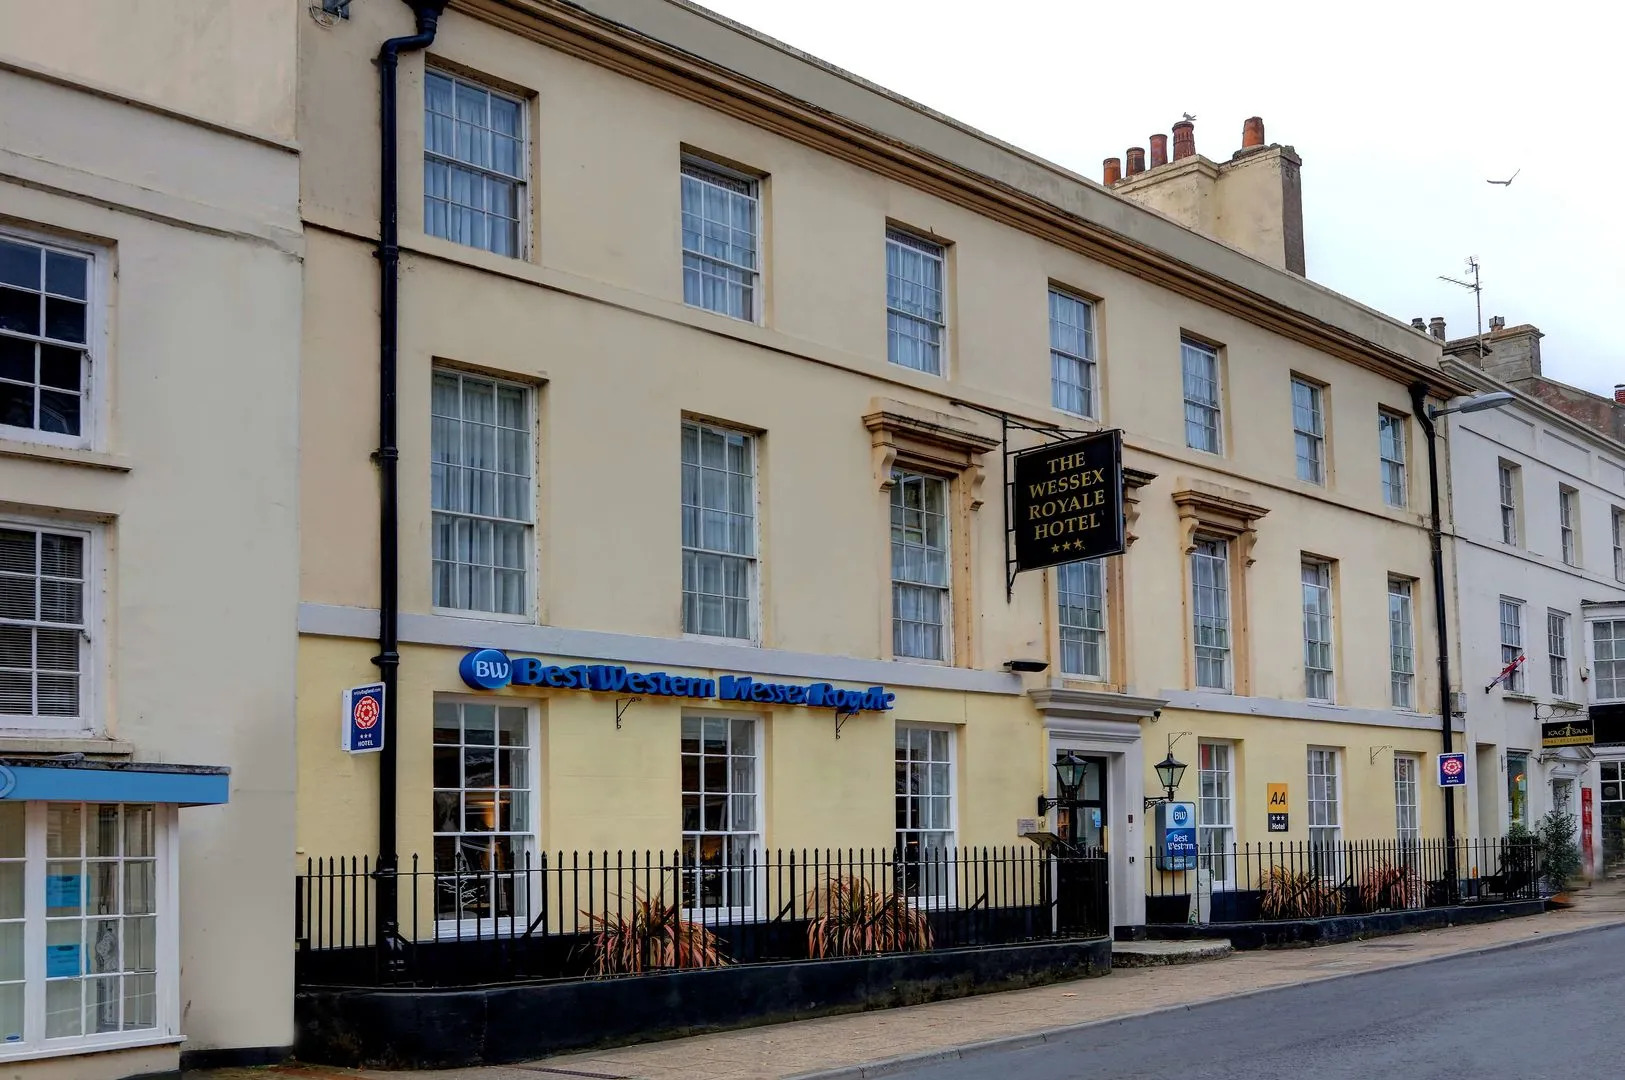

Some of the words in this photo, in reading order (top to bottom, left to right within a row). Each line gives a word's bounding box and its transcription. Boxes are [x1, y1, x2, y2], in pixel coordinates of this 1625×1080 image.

[1047, 452, 1085, 474] THE
[1028, 467, 1104, 498] WESSEX
[1028, 489, 1105, 520] ROYALE
[1034, 512, 1100, 540] HOTEL
[476, 661, 509, 679] BW
[512, 658, 590, 688] Best
[590, 664, 716, 698] Western
[719, 675, 811, 705] Wessex
[807, 682, 896, 713] Royale
[1270, 791, 1286, 805] AA
[1174, 811, 1187, 820] BW
[1271, 822, 1286, 830] Hotel
[1173, 834, 1188, 842] Best
